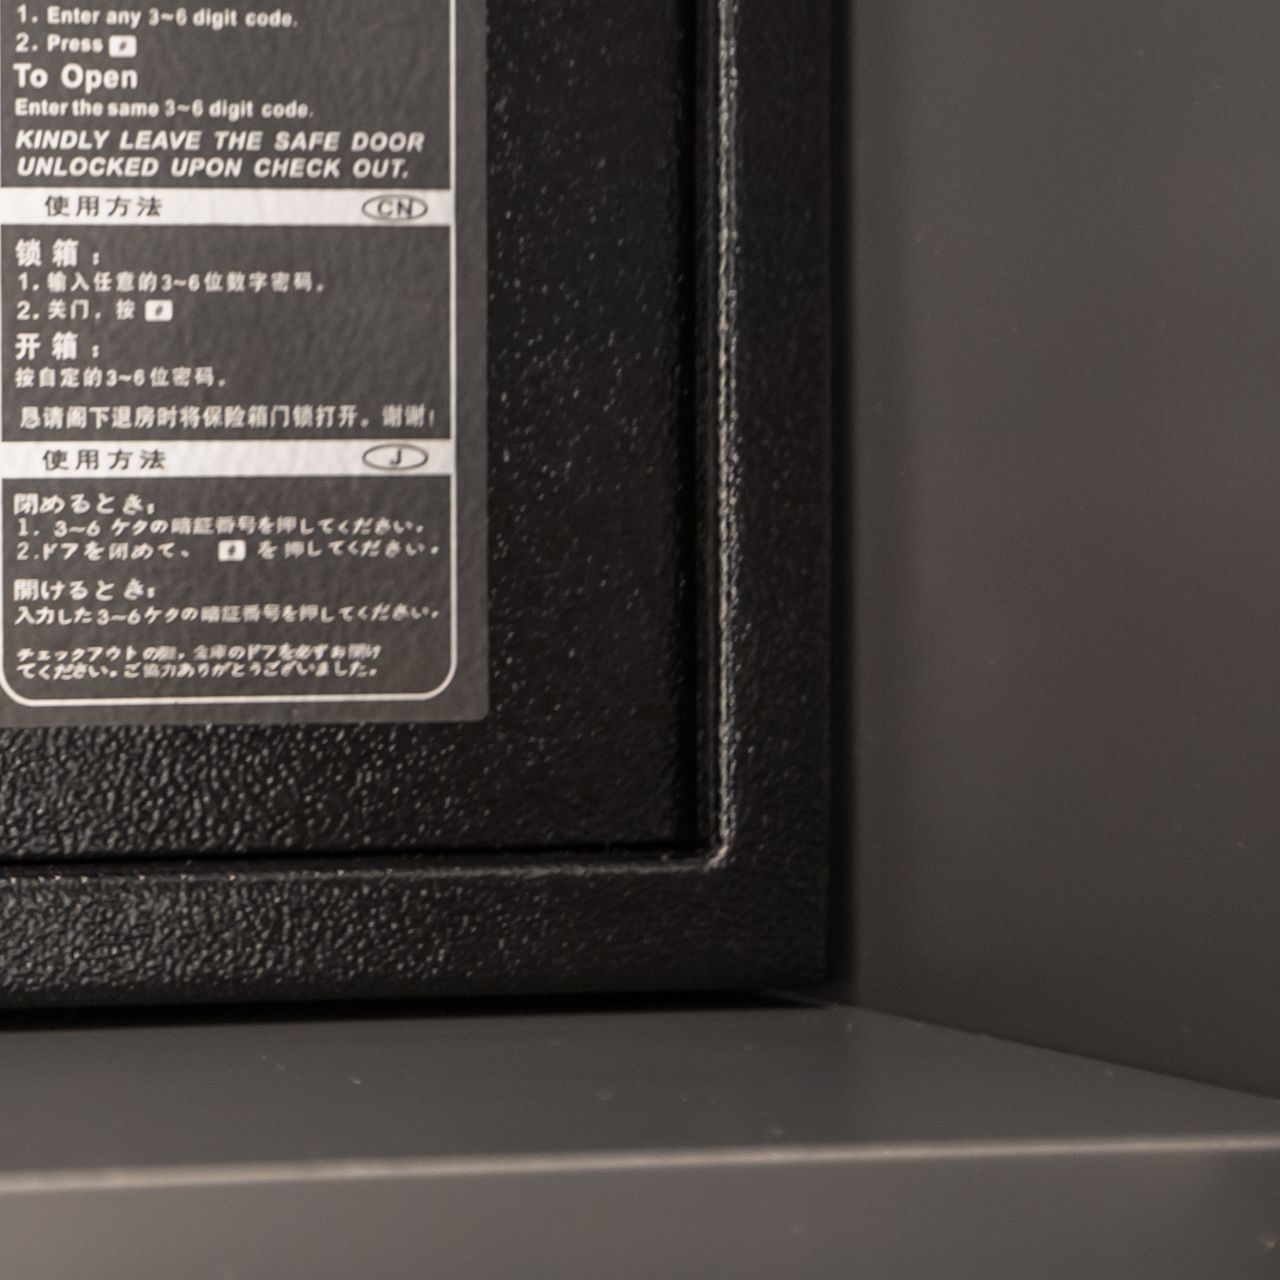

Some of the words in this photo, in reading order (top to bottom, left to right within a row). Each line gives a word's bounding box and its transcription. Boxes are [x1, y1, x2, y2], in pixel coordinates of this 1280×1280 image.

[17, 4, 39, 24] 1.
[46, 5, 101, 25] Enter
[105, 10, 142, 29] any
[148, 7, 188, 26] 3~6
[192, 8, 238, 31] digit
[15, 31, 39, 53] 2.
[46, 33, 104, 53] Press
[12, 62, 49, 89] To
[60, 62, 138, 95] Open
[14, 97, 69, 117] Enter
[71, 98, 104, 117] the
[107, 102, 160, 118] same
[164, 98, 204, 118] 3~6
[208, 99, 254, 122] digit
[15, 129, 111, 150] KINDLY
[119, 129, 202, 151] LEAVE
[214, 130, 263, 151] THE
[274, 130, 341, 152] SAFE
[351, 131, 425, 153] DOOR
[16, 156, 160, 177] UNLOCKED
[170, 157, 243, 178] UPON
[253, 157, 341, 178] CHECK
[352, 157, 409, 179] OUT.
[44, 195, 162, 217] 使用方法
[378, 199, 413, 216] CN
[42, 448, 166, 471] 使用方法
[389, 449, 402, 465] J
